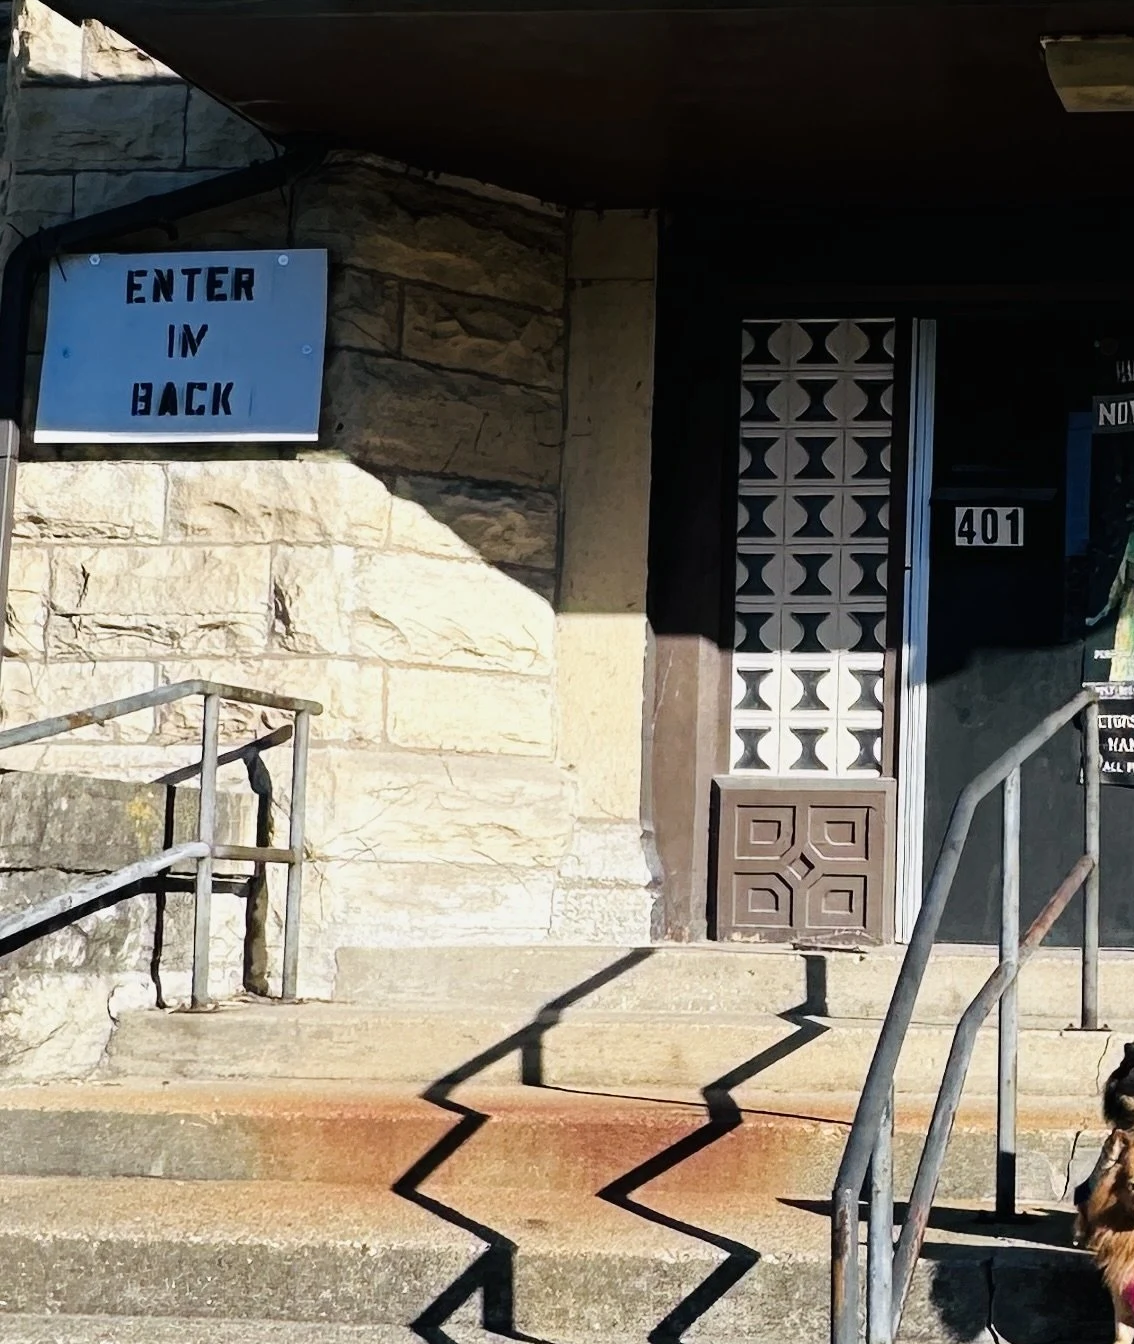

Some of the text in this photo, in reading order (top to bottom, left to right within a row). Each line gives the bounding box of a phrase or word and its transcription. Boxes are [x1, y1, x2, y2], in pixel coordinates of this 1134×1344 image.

[126, 266, 255, 304] ENTER
[167, 323, 209, 358] IN
[131, 381, 234, 416] BACK
[958, 508, 1019, 545] 401
[1102, 761, 1124, 773] ALL
